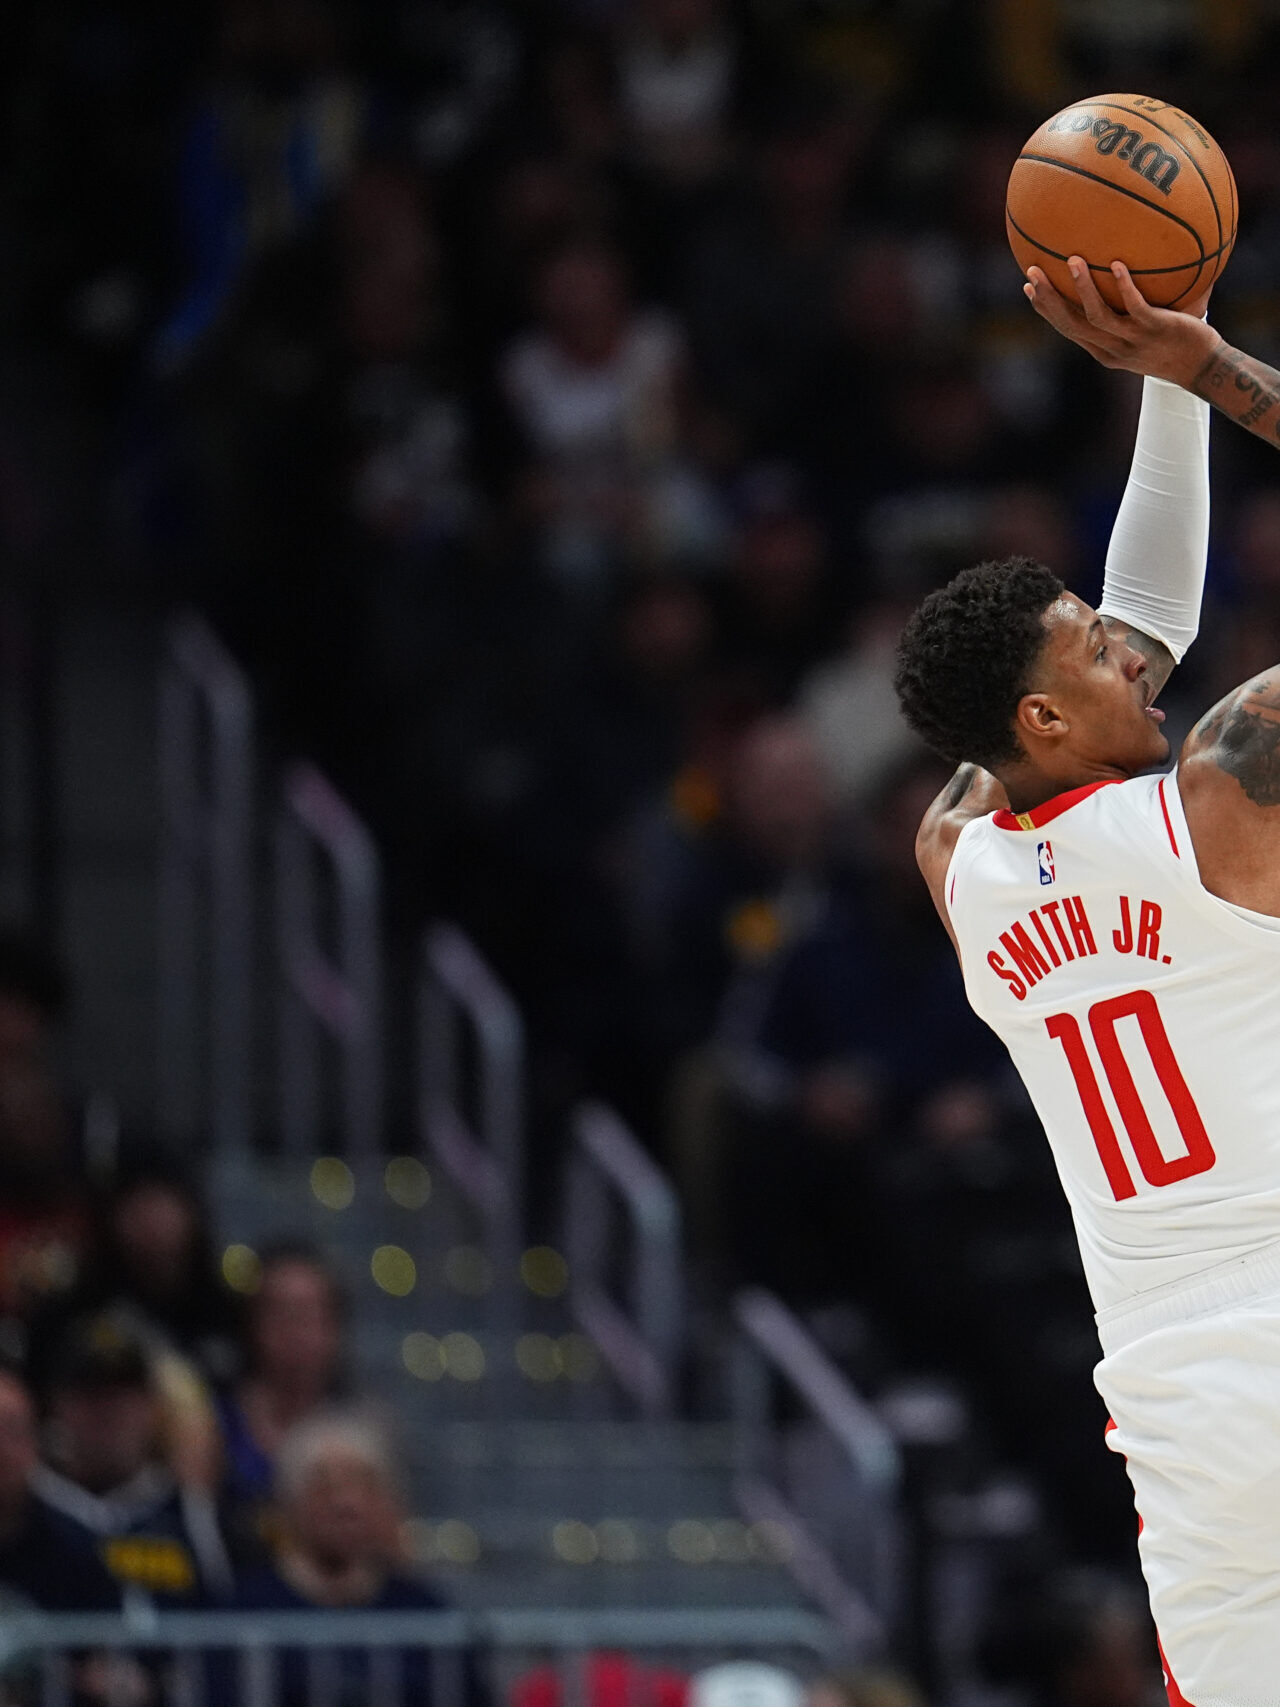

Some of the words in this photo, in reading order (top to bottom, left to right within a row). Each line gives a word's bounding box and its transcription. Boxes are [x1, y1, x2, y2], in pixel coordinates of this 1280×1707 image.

[1048, 113, 1181, 196] Wilson
[987, 895, 1098, 1001] SMITH
[1112, 895, 1172, 965] JR.
[1044, 989, 1216, 1202] 10
